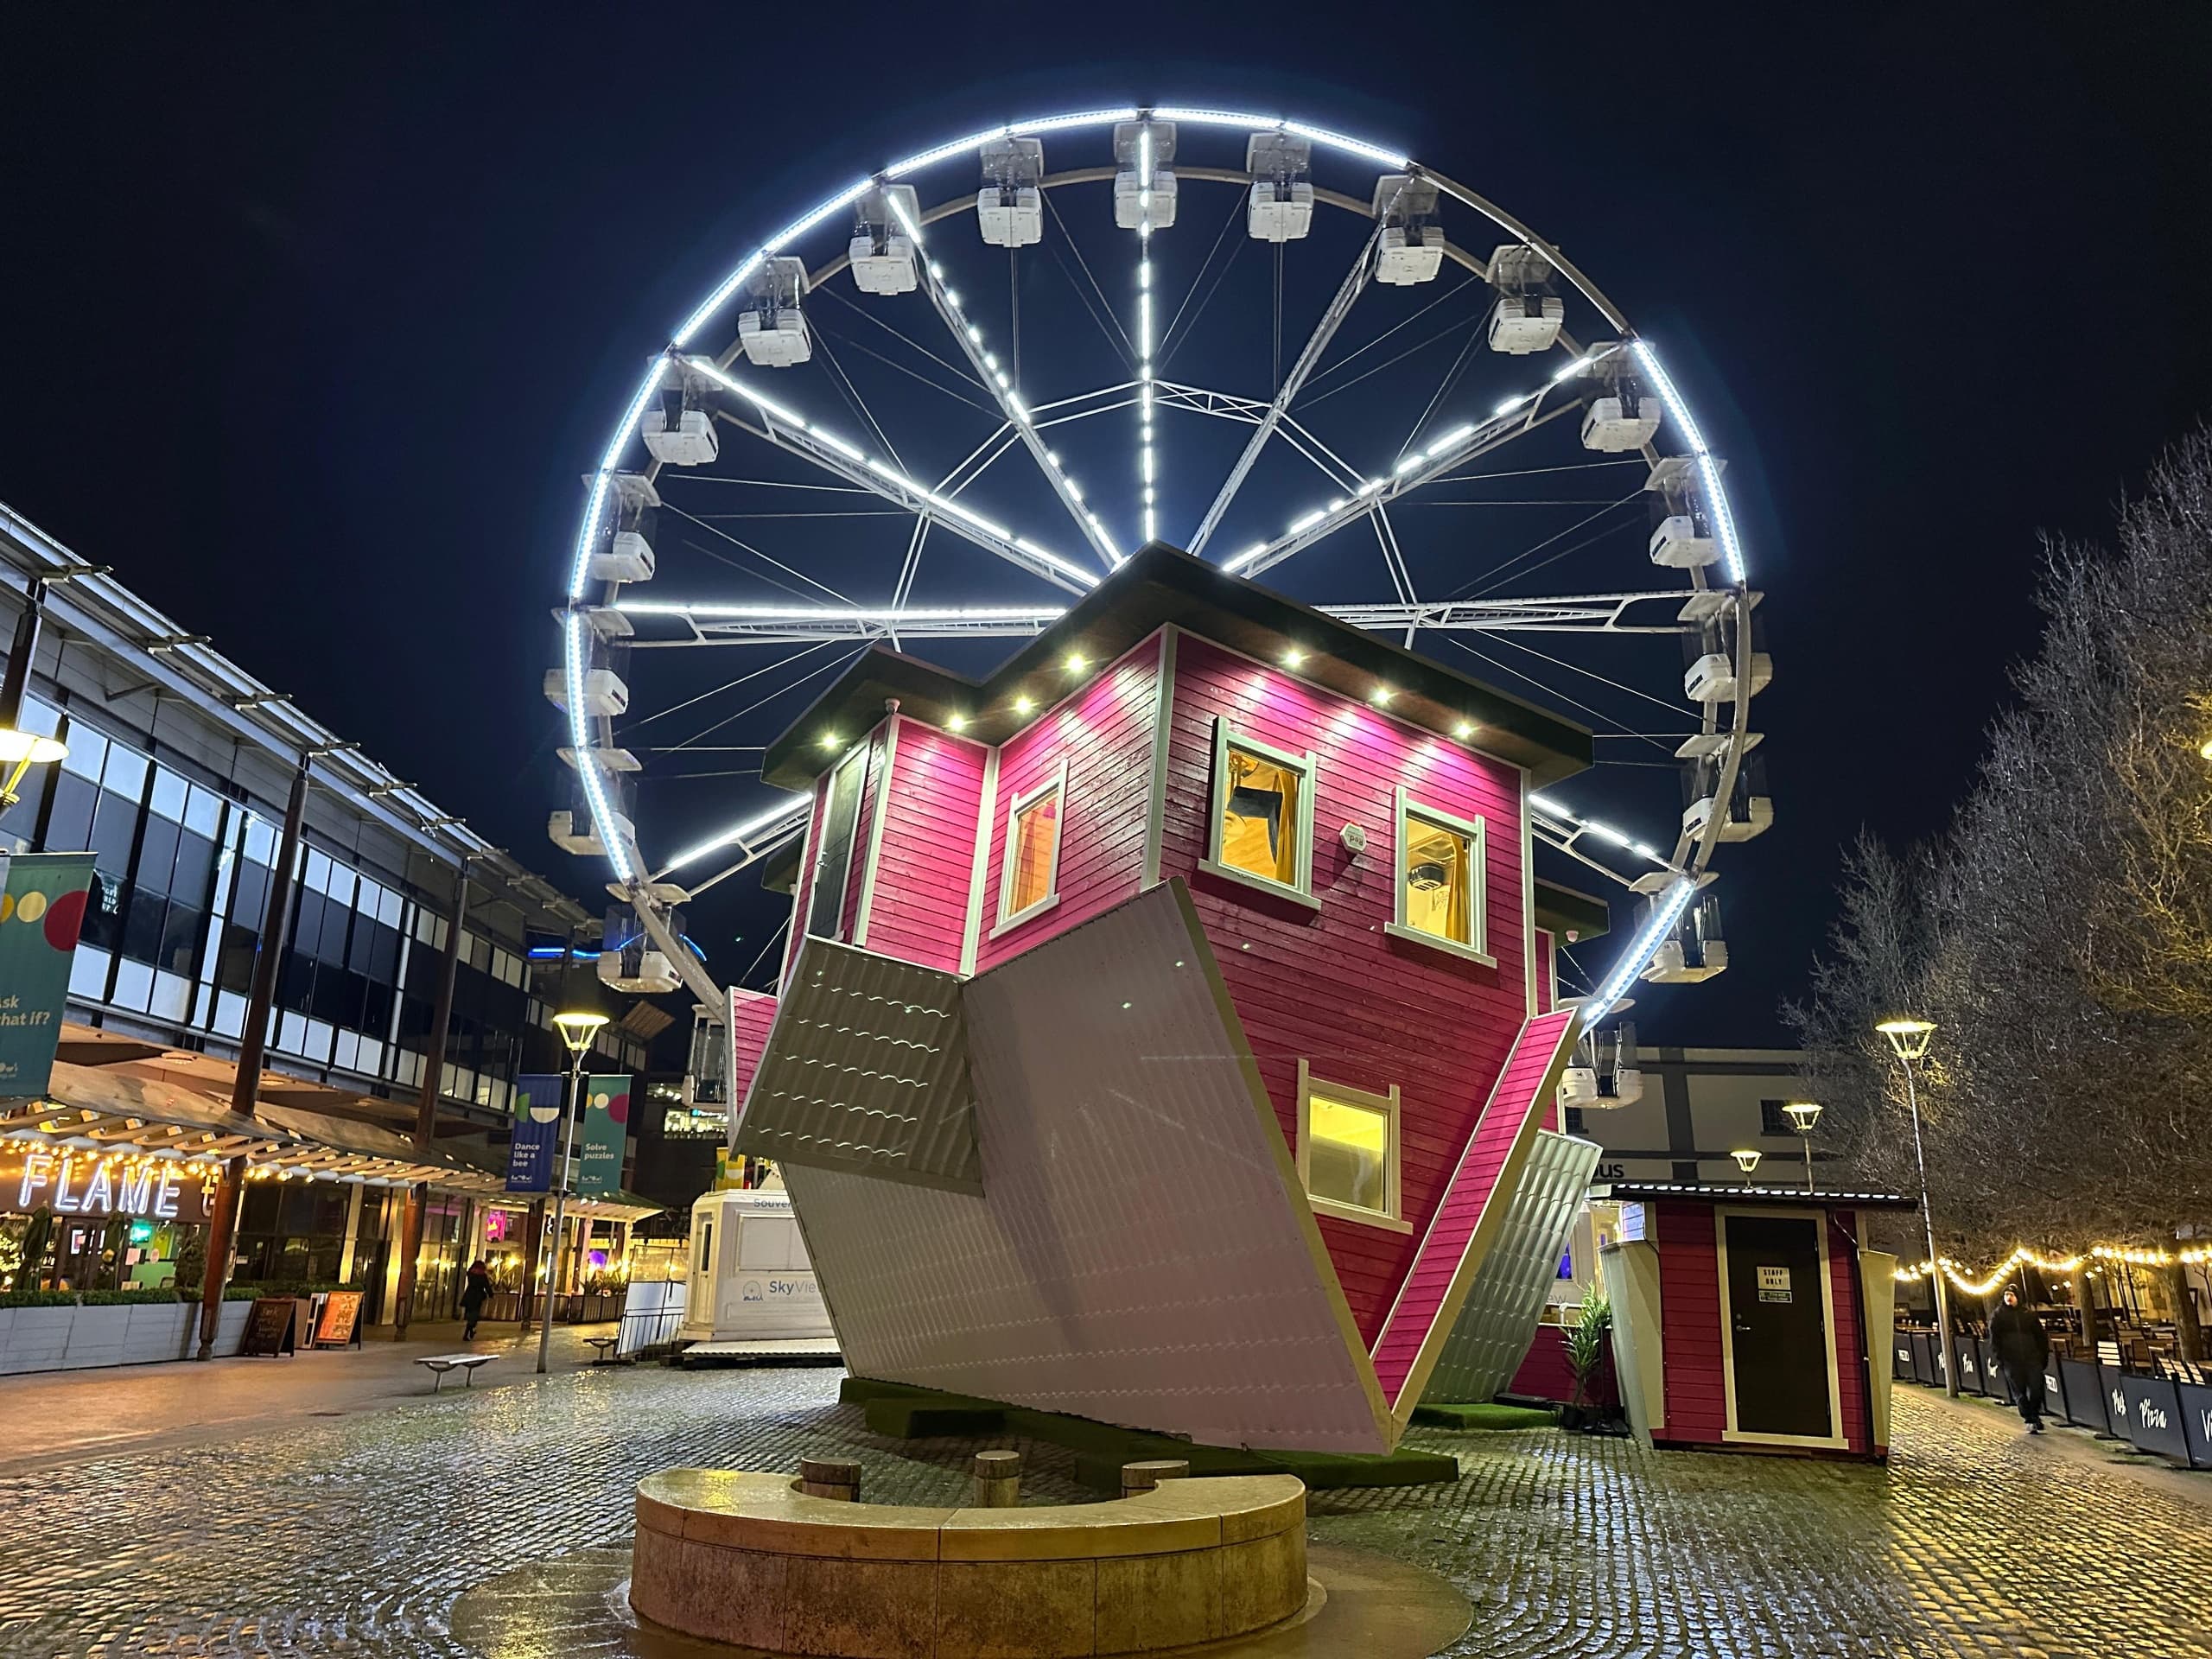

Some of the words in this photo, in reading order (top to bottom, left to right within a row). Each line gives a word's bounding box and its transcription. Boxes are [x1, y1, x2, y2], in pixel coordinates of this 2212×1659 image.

[0, 995, 19, 1009] sk
[0, 1012, 27, 1027] hat
[29, 1011, 50, 1026] if?
[514, 1142, 541, 1151] Dance
[585, 1142, 607, 1151] Solve
[584, 1152, 614, 1160] puzzles
[1597, 1164, 1624, 1179] us
[18, 1154, 181, 1218] FLAME
[1764, 1268, 1783, 1277] STAFF
[769, 1280, 817, 1295] SkyVie
[2139, 1398, 2167, 1428] Pizza
